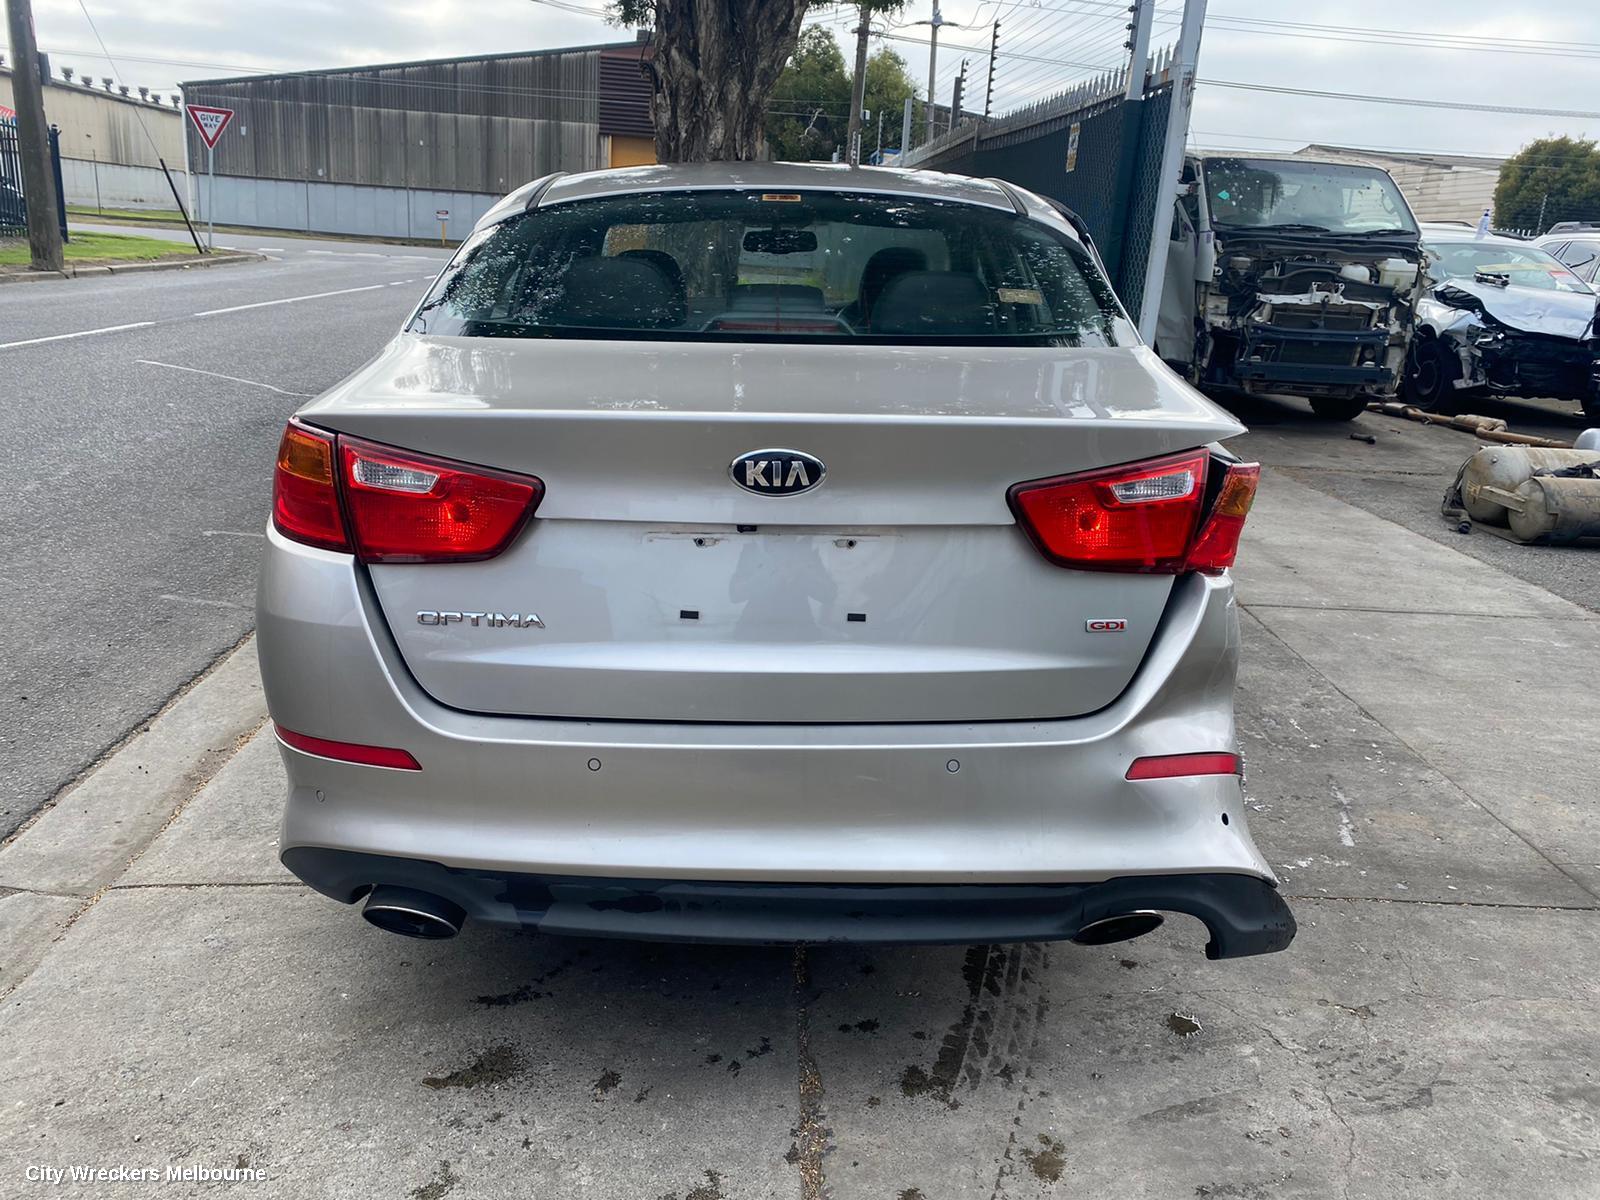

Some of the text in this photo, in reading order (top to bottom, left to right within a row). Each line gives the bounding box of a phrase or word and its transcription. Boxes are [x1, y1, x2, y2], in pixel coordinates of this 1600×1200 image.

[200, 114, 221, 123] GIVE
[744, 460, 811, 487] KIA
[416, 609, 546, 629] OPTIMA
